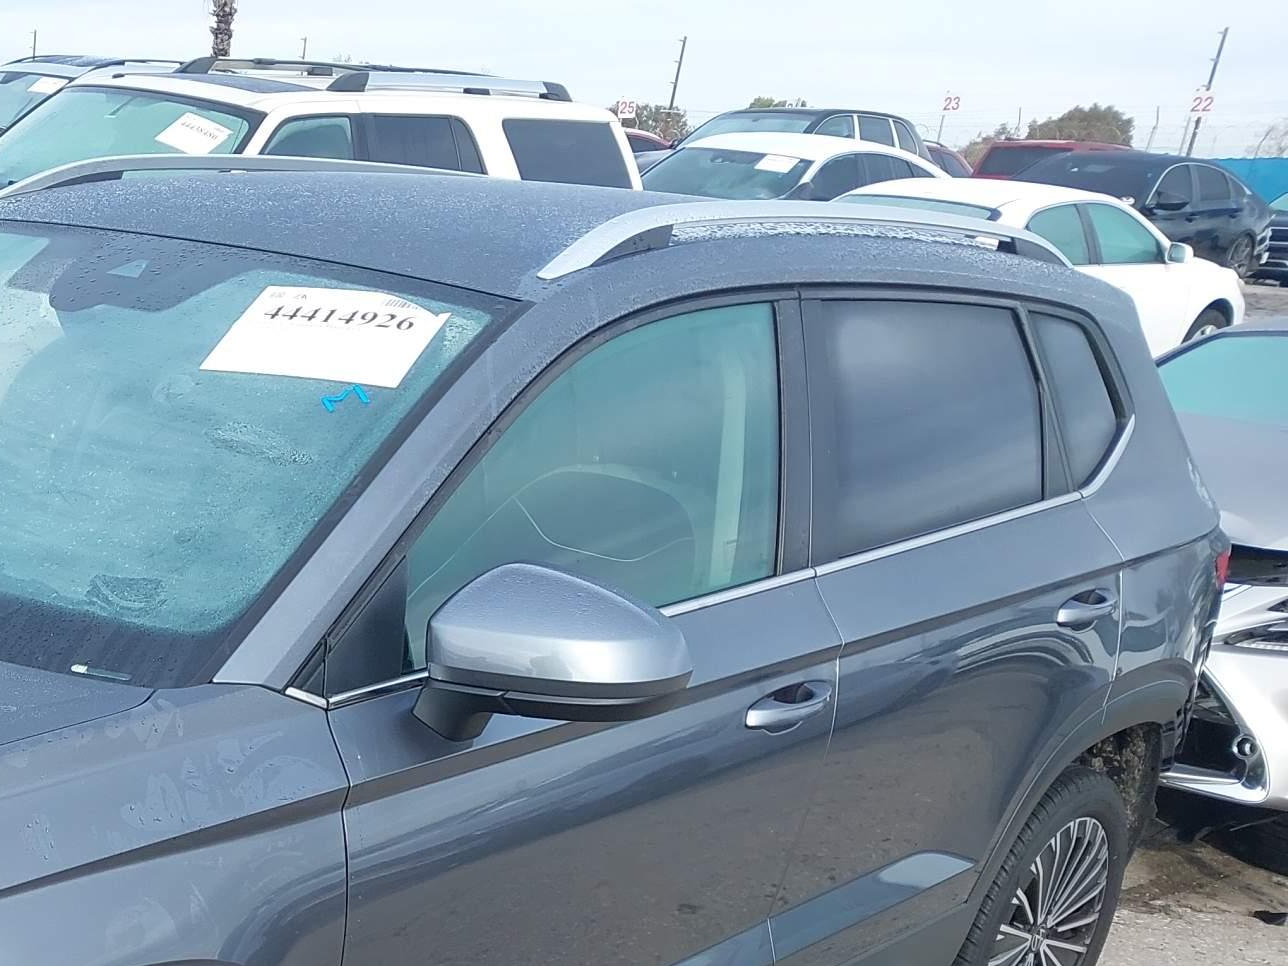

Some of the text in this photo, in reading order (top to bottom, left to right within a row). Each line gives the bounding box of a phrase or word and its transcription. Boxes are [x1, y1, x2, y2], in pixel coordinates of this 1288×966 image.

[620, 101, 635, 114] 25
[943, 96, 961, 111] 23
[1191, 96, 1214, 112] 22
[263, 305, 416, 331] 44414926
